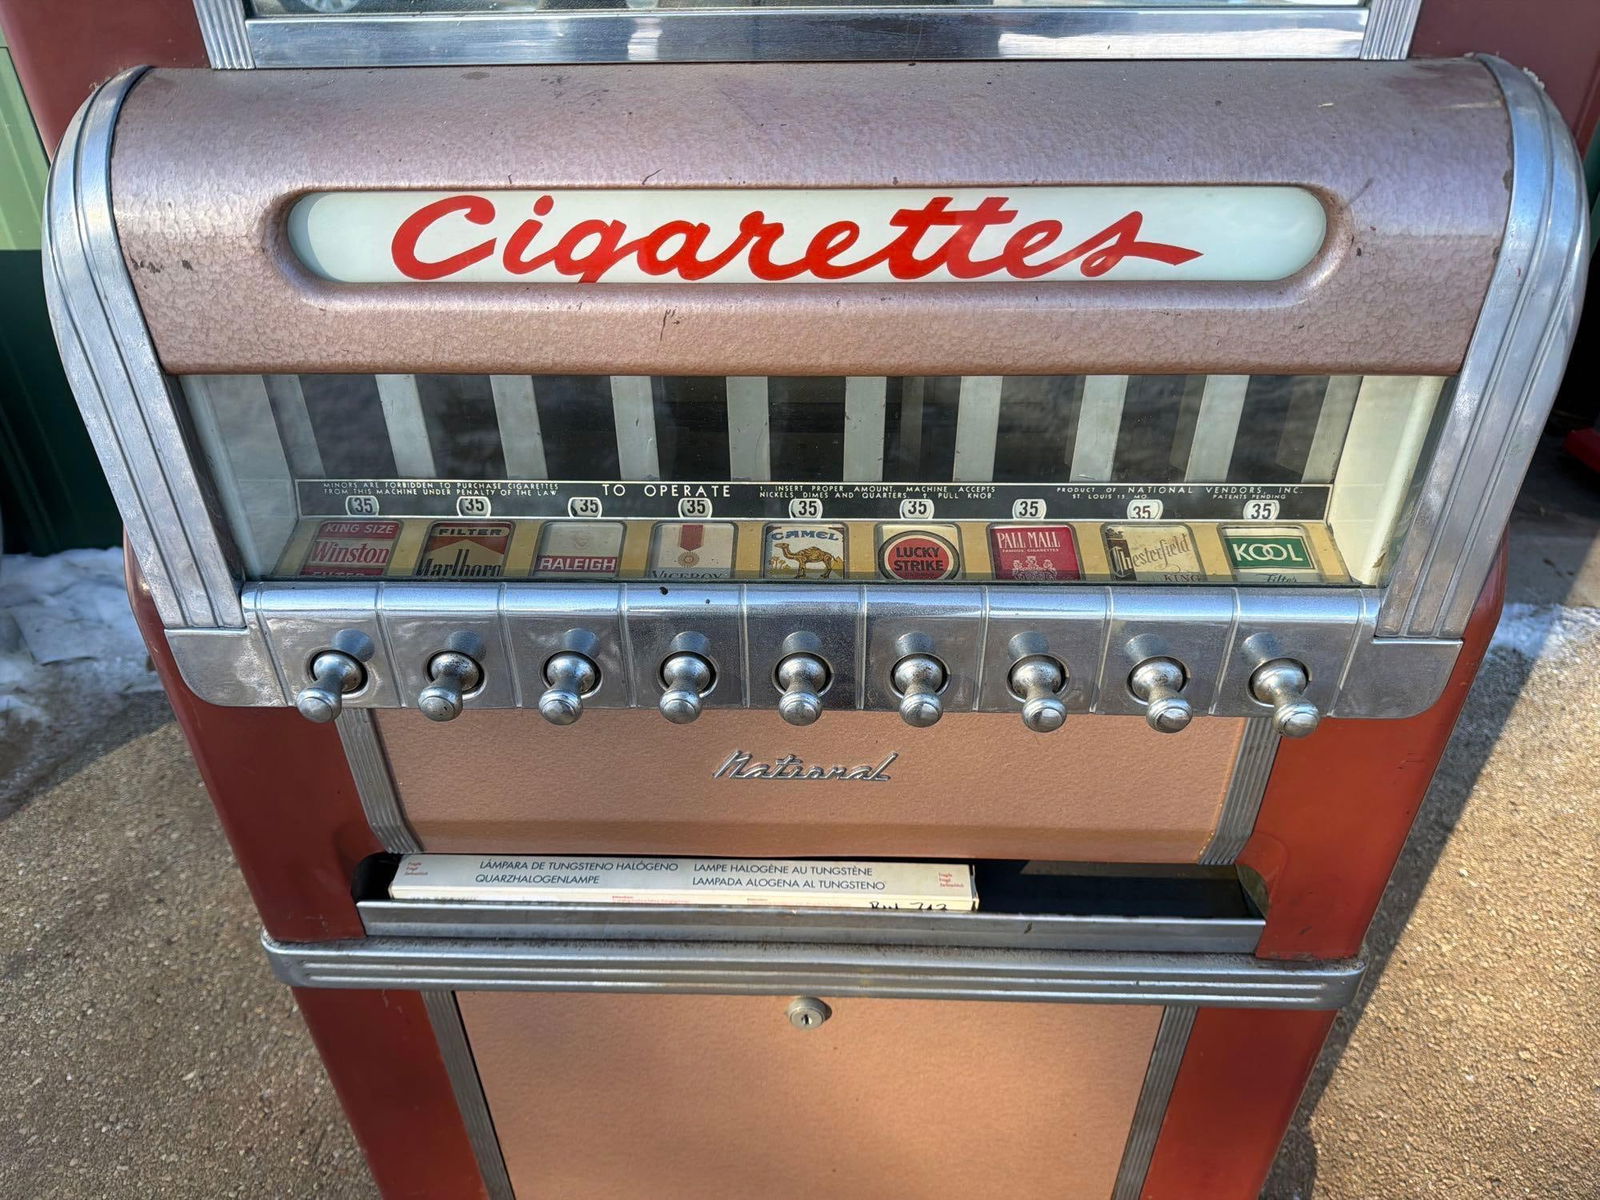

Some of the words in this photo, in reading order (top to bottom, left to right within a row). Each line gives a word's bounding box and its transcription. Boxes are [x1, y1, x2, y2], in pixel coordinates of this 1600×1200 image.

[392, 192, 1204, 284] Cigarettes
[457, 482, 501, 490] PURCHASE
[602, 484, 626, 497] TO
[644, 484, 731, 498] OPERATE
[1205, 487, 1266, 495] VENDORS,
[354, 498, 373, 514] 35
[465, 498, 485, 512] 35
[580, 499, 598, 513] 35
[686, 499, 706, 514] 35
[798, 500, 817, 516] 35
[908, 500, 927, 515] 35
[1019, 500, 1038, 517] 35
[1132, 505, 1151, 519] 35
[1251, 503, 1272, 519] 35
[326, 524, 359, 533] KING
[364, 524, 395, 534] SIZE
[439, 528, 502, 536] FILTER
[771, 530, 839, 541] CAMEL
[996, 532, 1026, 549] PALL
[1027, 531, 1061, 548] MALL
[313, 540, 390, 564] Winston
[895, 546, 939, 558] LUCKY
[1109, 532, 1191, 578] Chesterfield
[1232, 543, 1303, 561] KOOL
[540, 557, 616, 571] RALEIGH
[893, 560, 943, 572] STRIKE
[1164, 574, 1200, 582] KING
[712, 750, 899, 781] National
[480, 859, 528, 870] LÁMPARA
[531, 861, 546, 870] DE
[549, 861, 614, 871] TUNGSTENO
[616, 860, 678, 872] HALÓGENO
[694, 863, 727, 873] LAMPE
[730, 864, 789, 874] HALOGÈNE
[792, 866, 808, 875] AU
[810, 865, 873, 877] TUNGSTÈNE
[475, 873, 600, 884] QUARZHALOGENLAMPE
[692, 876, 743, 886] LAMPADA
[746, 878, 800, 888] ALOGENA
[802, 879, 816, 889] AL
[819, 880, 885, 891] TUNGSTENO
